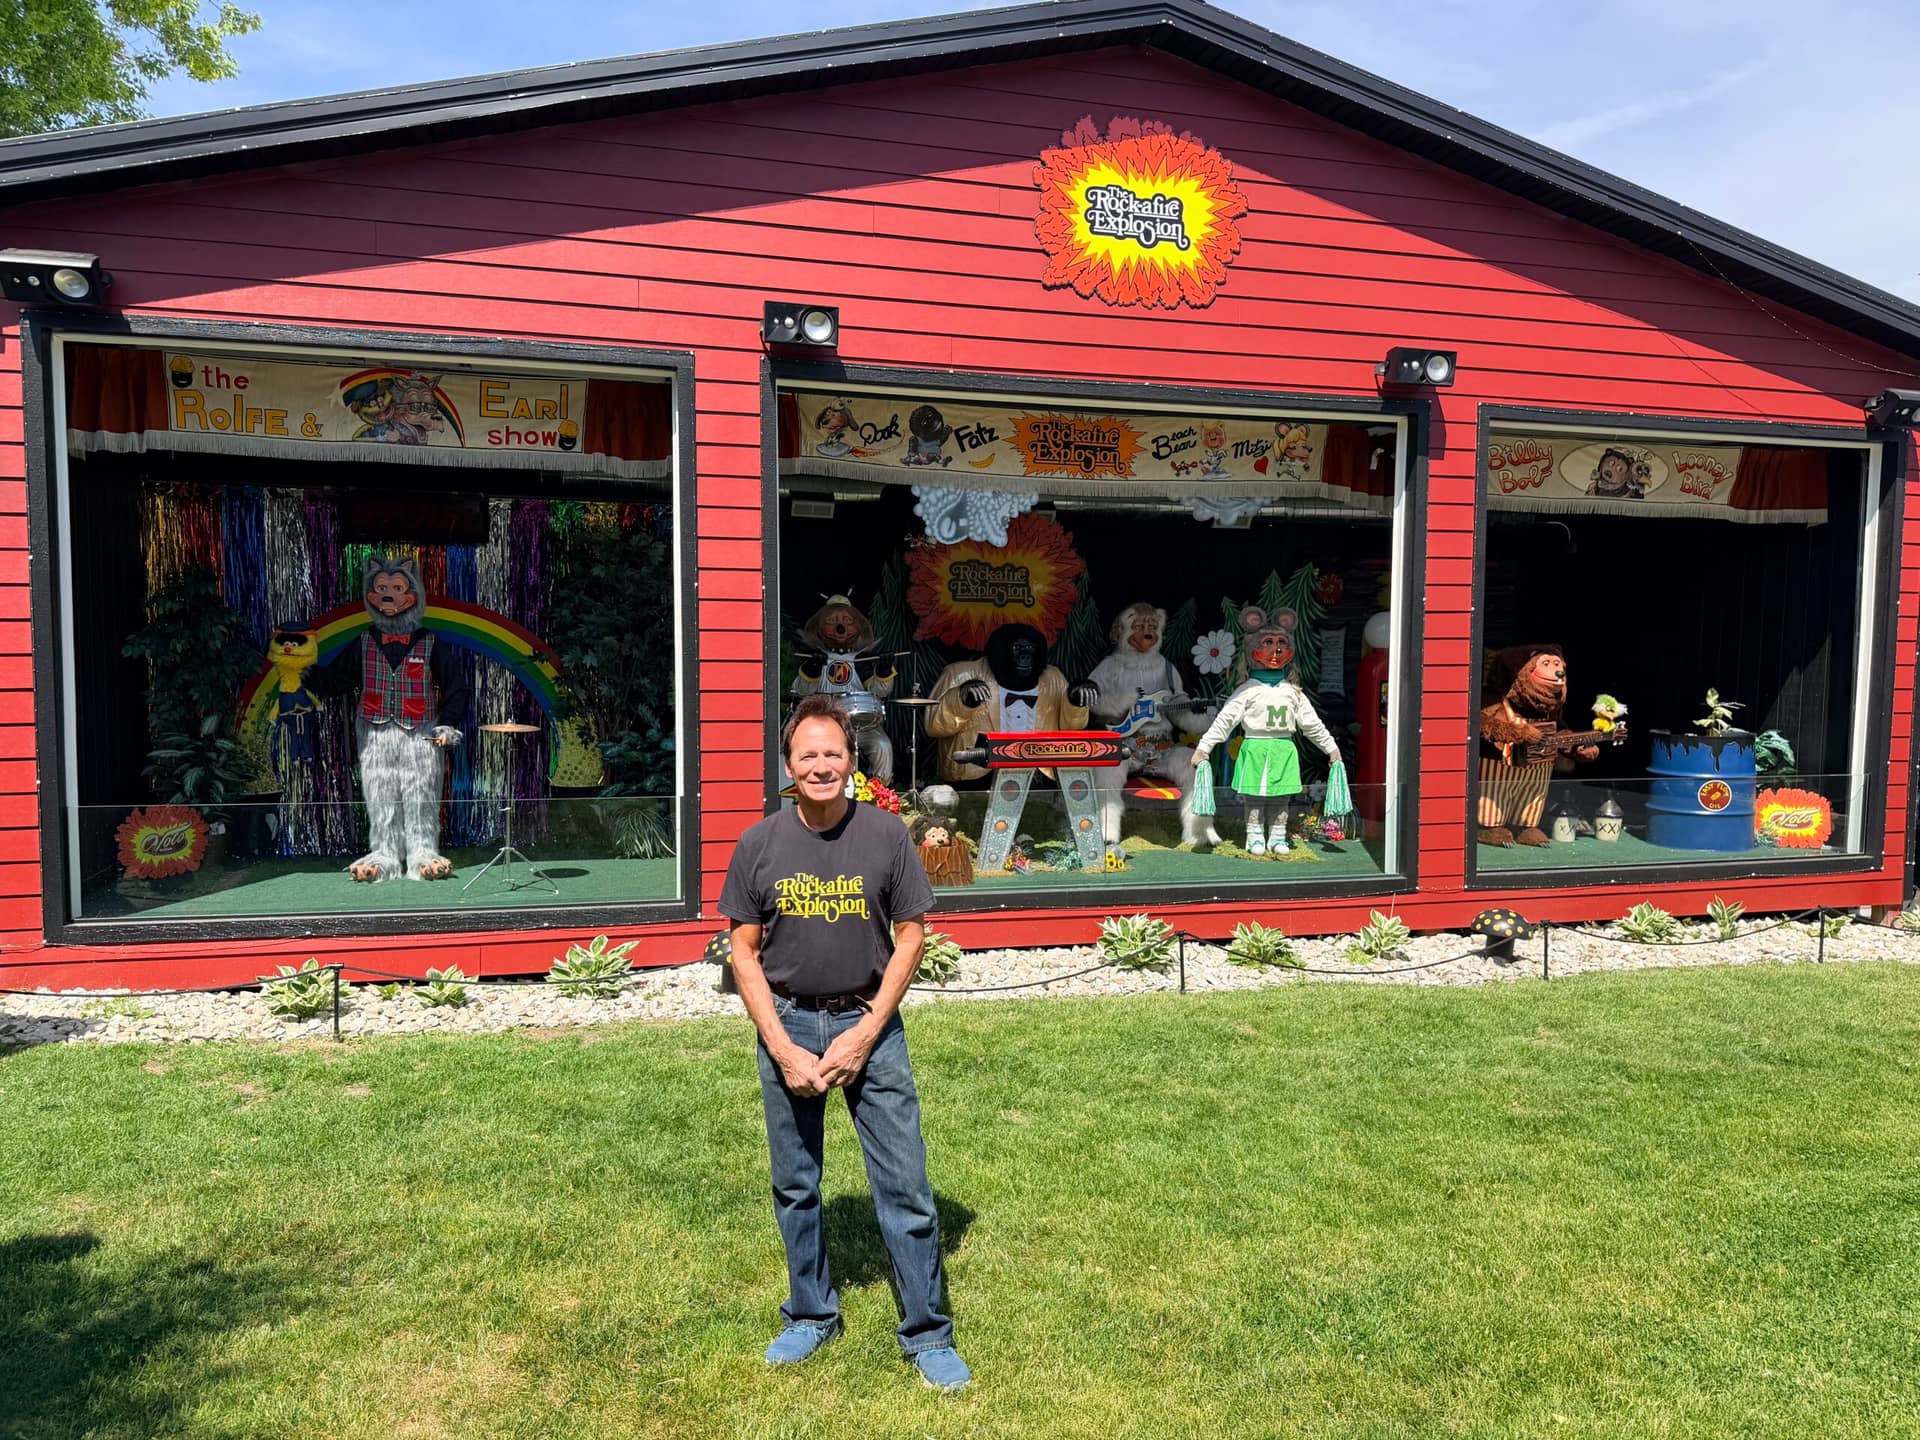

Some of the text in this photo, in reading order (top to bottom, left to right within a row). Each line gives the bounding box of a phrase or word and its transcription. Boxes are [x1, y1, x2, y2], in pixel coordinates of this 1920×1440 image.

[1087, 189, 1180, 219] Rock-afire
[1107, 186, 1129, 199] The
[1087, 210, 1188, 248] Explosion
[201, 365, 250, 389] the
[301, 412, 323, 437] &
[487, 425, 558, 446] show
[953, 422, 1000, 452] Fatz
[1052, 420, 1070, 431] The
[1028, 440, 1127, 474] Explosion
[1231, 438, 1272, 459] Mitzi
[1488, 439, 1554, 472] Billy
[1498, 465, 1553, 493] Bob
[1672, 451, 1734, 484] Looney
[1680, 472, 1713, 500] Bird
[950, 582, 1035, 607] Explosion
[1266, 705, 1288, 727] M
[774, 875, 864, 900] Rock-afire
[794, 872, 814, 882] The
[775, 895, 871, 923] Explosion
